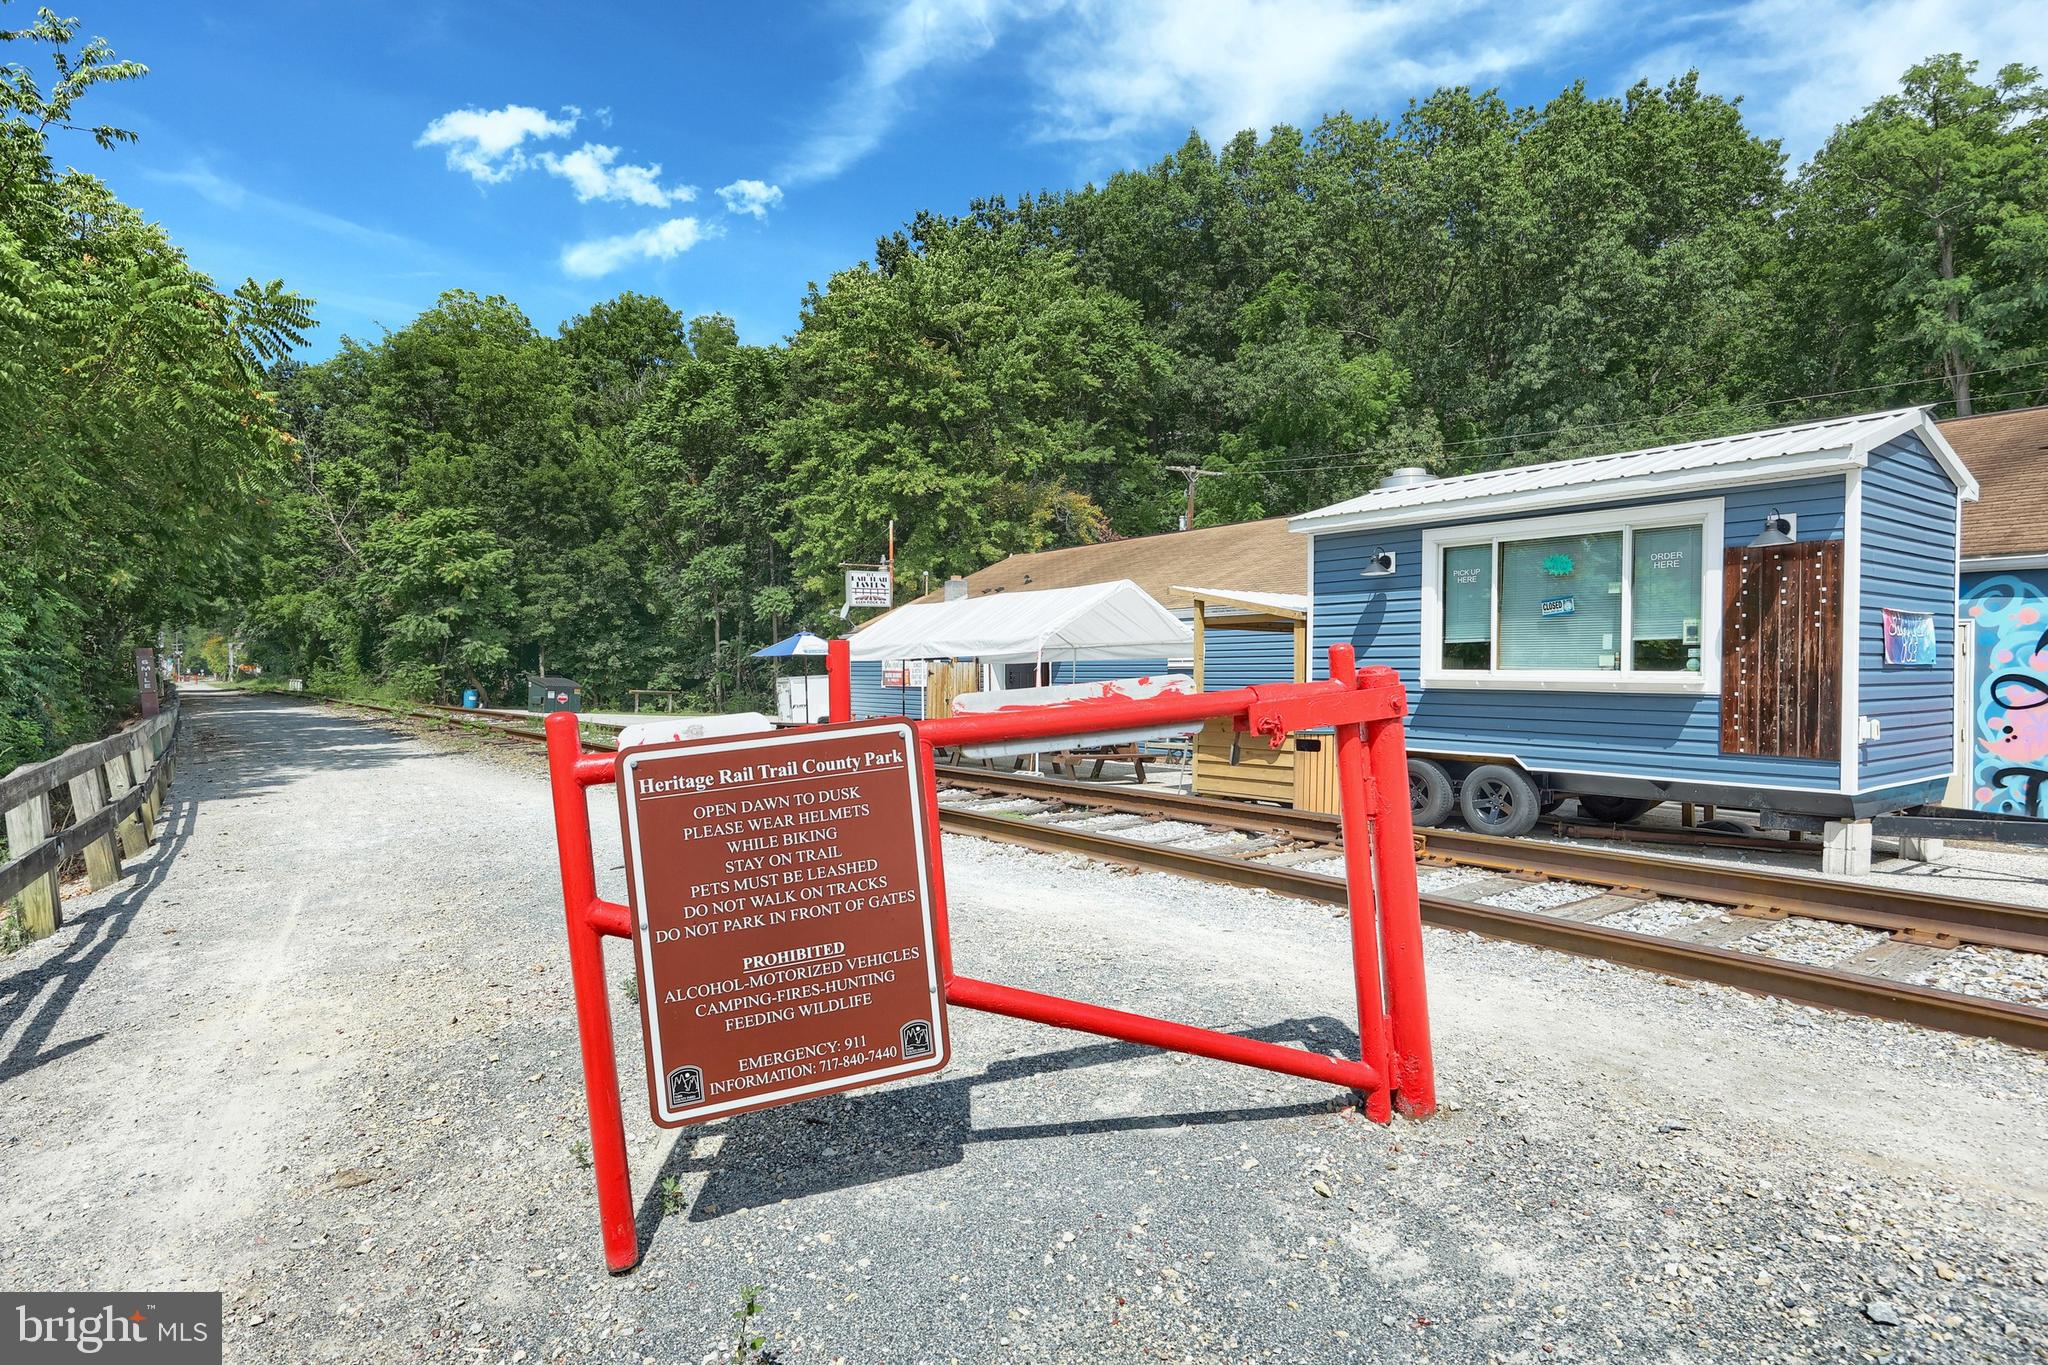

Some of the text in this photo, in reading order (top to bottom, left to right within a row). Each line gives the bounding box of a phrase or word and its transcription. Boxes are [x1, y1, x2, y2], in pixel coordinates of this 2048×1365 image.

[1650, 551, 1683, 561] ORDER
[1653, 560, 1680, 569] HERE
[1453, 568, 1481, 577] PICK UP
[1457, 575, 1477, 584] HERE
[1543, 600, 1563, 610] CLOSED
[140, 666, 151, 689] MILE
[638, 749, 904, 795] Heritage Rail Trail County Park
[693, 786, 862, 820] OPEN DAWN TO DUSK
[683, 803, 870, 841] PLEASE WEAR HELMETS
[726, 827, 838, 854] WHILE BIKING
[725, 845, 843, 874] STAY ON TRAIL
[690, 859, 878, 899] PETS MUST BE LEASHED
[683, 875, 888, 919] DO NOT WALK ON TRACKS
[655, 889, 916, 944] DO NOT PARK IN FRONT OF GATES
[742, 941, 845, 970] PROHIBITED
[845, 946, 920, 970] VEHICLES
[725, 992, 873, 1032] FEEDING WILDLIFE
[738, 1035, 866, 1072] EMERGENCY: 911
[709, 1062, 817, 1096] INFORMATION:
